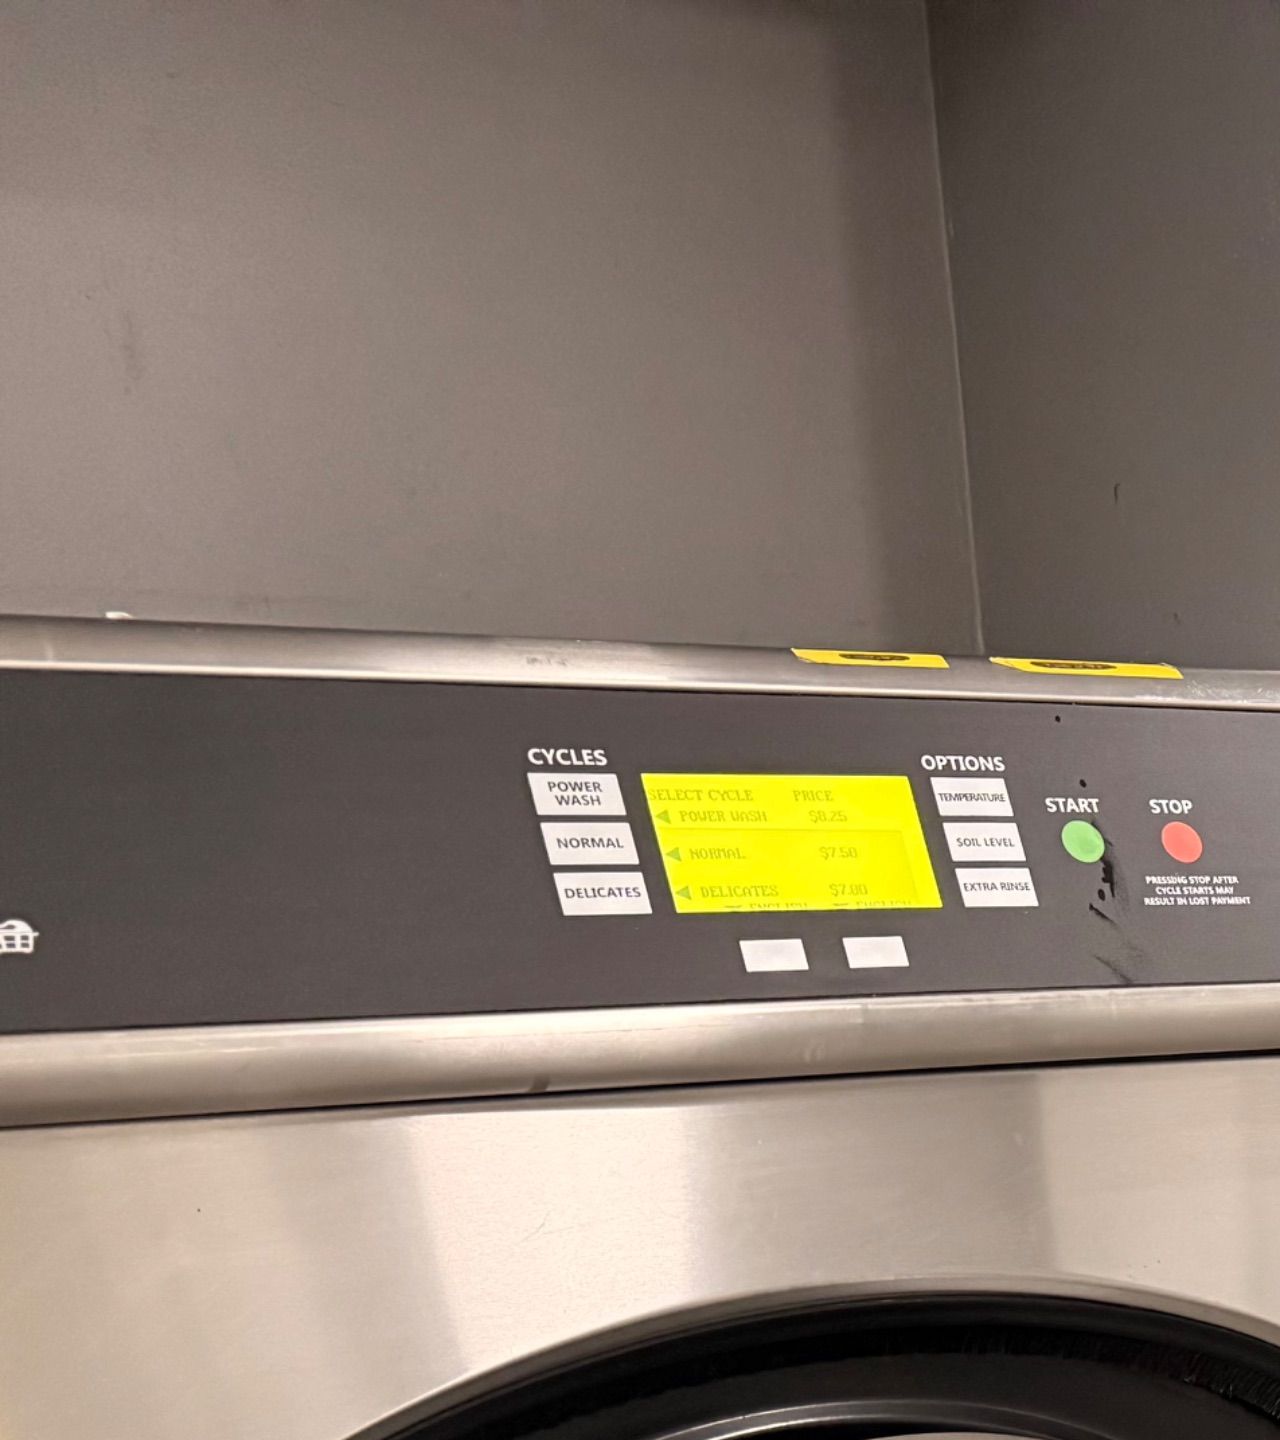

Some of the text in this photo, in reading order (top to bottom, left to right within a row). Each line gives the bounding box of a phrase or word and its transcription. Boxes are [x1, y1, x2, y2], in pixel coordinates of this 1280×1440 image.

[527, 748, 608, 767] CYCLES
[921, 755, 1005, 773] OPTIONS
[547, 781, 603, 794] POWER
[554, 793, 602, 807] WASH
[649, 789, 834, 802] SELECT CYCLE PRICE
[938, 791, 1007, 802] TEMPERATURE
[1045, 797, 1100, 814] START
[1149, 799, 1193, 815] STOP
[679, 810, 848, 823] POWER WASH $8.25
[556, 835, 625, 851] NORMAL
[956, 837, 1015, 848] SOIL LEVEL
[689, 846, 858, 860] NORMAL $7.50
[1145, 875, 1239, 884] PRESSING STOP AFTER
[564, 886, 642, 900] DELICATES
[700, 884, 868, 898] DELICATES $7.00
[962, 881, 1031, 893] EXTRA RINSE
[1155, 886, 1234, 895] CYCLE STARTS MAY
[1144, 896, 1251, 906] RESULT IN LOST PAYMENT
